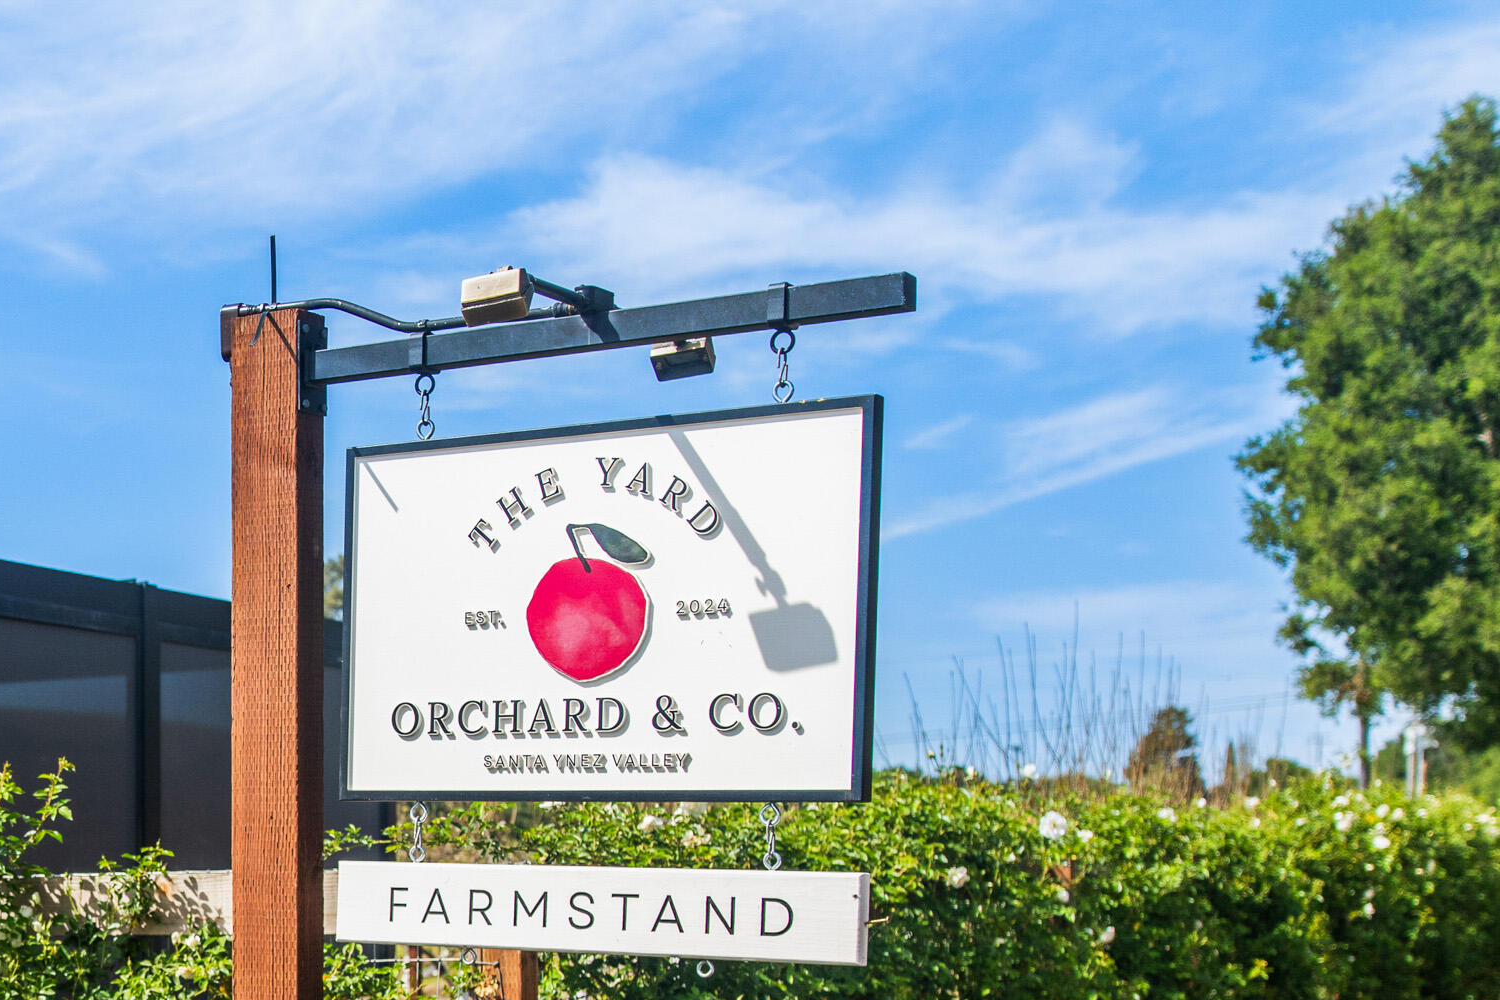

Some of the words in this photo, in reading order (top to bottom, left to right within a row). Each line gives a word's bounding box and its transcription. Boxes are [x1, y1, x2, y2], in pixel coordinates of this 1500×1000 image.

[468, 467, 562, 548] THE
[595, 456, 722, 535] YARD
[464, 610, 504, 627] EST.
[676, 598, 730, 617] 2024
[391, 697, 626, 737] ORCHARD
[652, 694, 684, 733] &
[708, 692, 800, 732] CO.
[483, 754, 546, 770] SANTA
[552, 753, 603, 769] YNEZ
[612, 753, 688, 769] VALLEY
[388, 886, 795, 937] FARMSTAND
